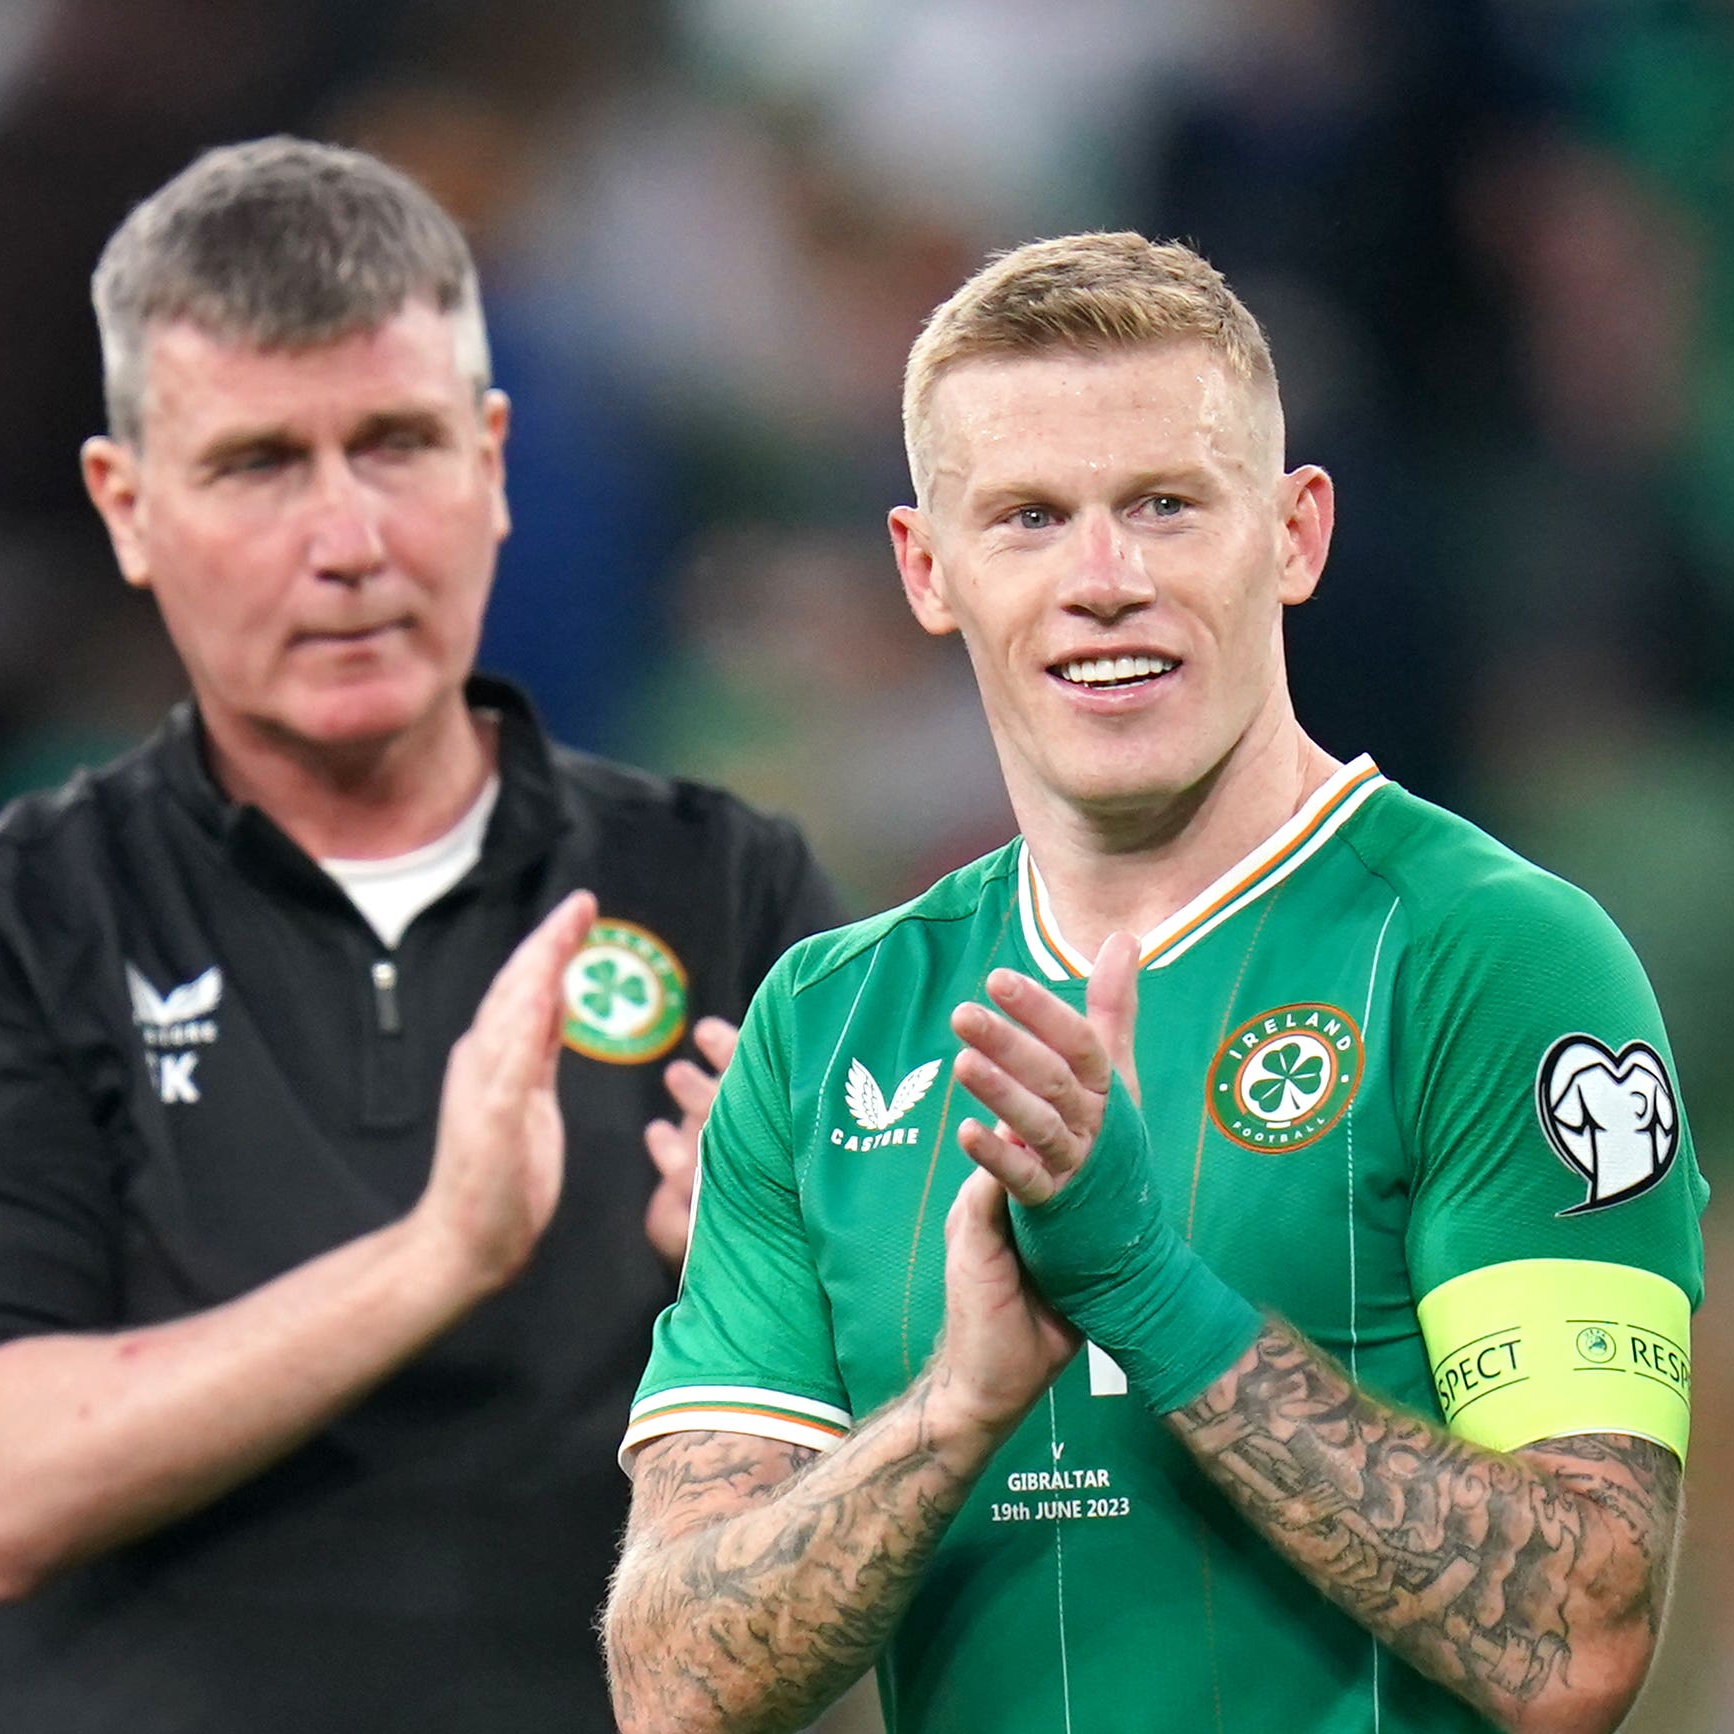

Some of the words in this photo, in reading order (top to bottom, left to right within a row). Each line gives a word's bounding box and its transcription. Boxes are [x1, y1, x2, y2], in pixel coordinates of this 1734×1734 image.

[1229, 1012, 1351, 1060] IRELAND
[831, 1128, 919, 1152] CASTORE
[1232, 1118, 1324, 1143] FOOTBALL
[1438, 1340, 1521, 1410] SPECT
[1631, 1337, 1690, 1389] RESP
[1051, 1442, 1065, 1460] V
[1007, 1469, 1110, 1492] GIBRALTAR
[991, 1502, 1030, 1521] 19th
[1035, 1500, 1082, 1520] JUNE
[1087, 1497, 1130, 1518] 2023
